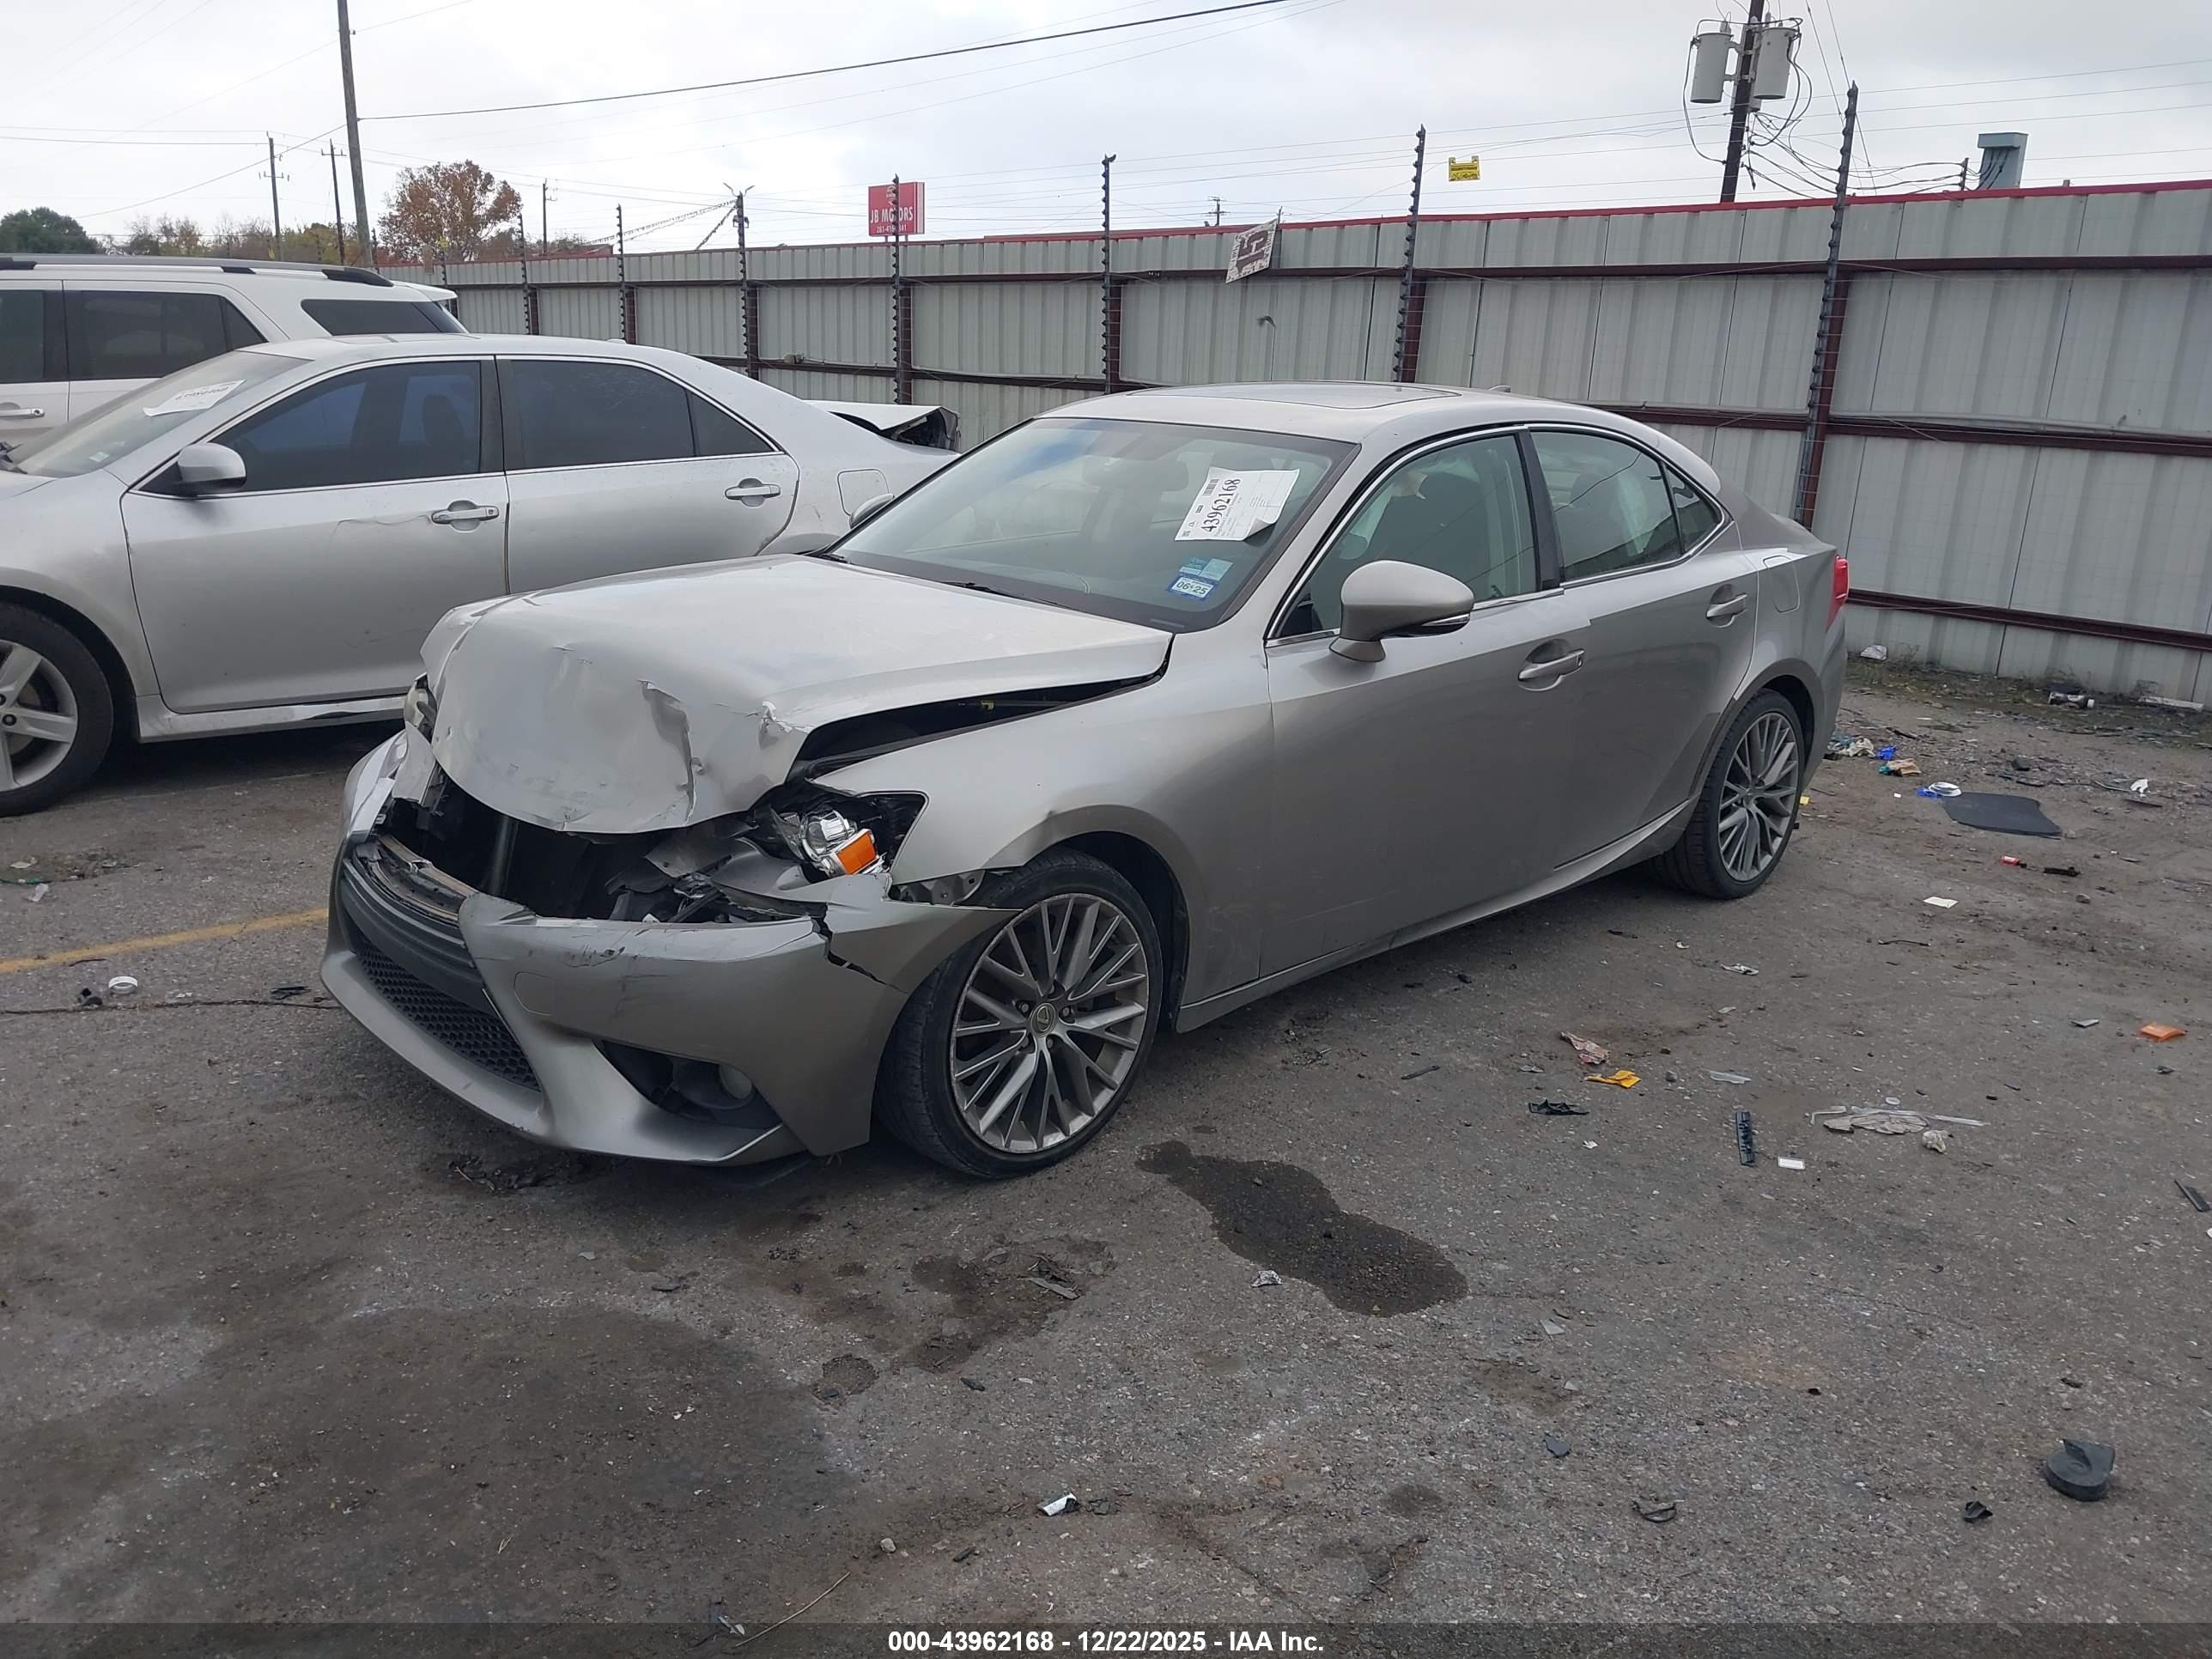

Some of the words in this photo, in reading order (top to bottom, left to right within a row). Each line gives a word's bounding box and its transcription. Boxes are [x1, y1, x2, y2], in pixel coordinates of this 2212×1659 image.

[870, 210, 879, 223] JB
[881, 206, 914, 222] MOORS
[1200, 477, 1241, 533] 43962168
